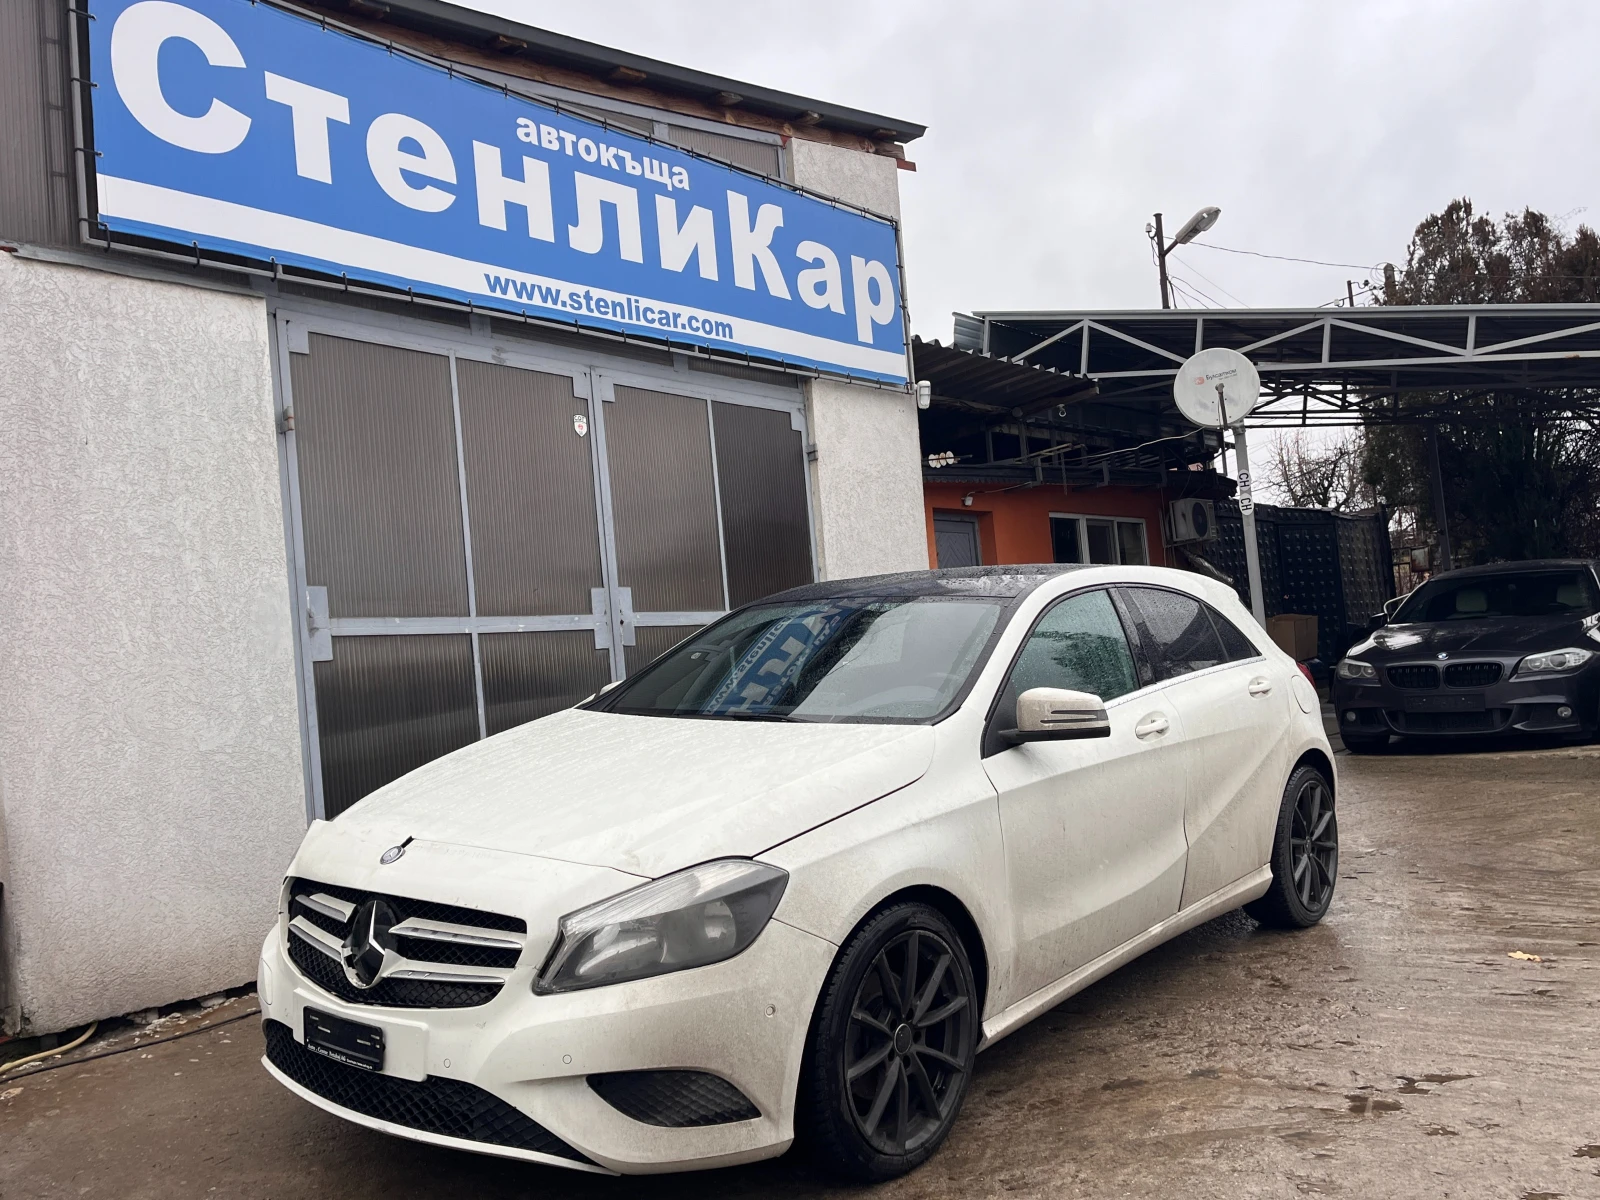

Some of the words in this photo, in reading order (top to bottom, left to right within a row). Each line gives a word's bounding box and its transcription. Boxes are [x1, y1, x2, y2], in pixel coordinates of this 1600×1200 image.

[110, 1, 895, 344] СтенлиКар
[516, 117, 690, 191] автокъща
[484, 273, 733, 340] www.stenlicar.com
[1239, 473, 1250, 488] CH
[1241, 497, 1252, 511] CH
